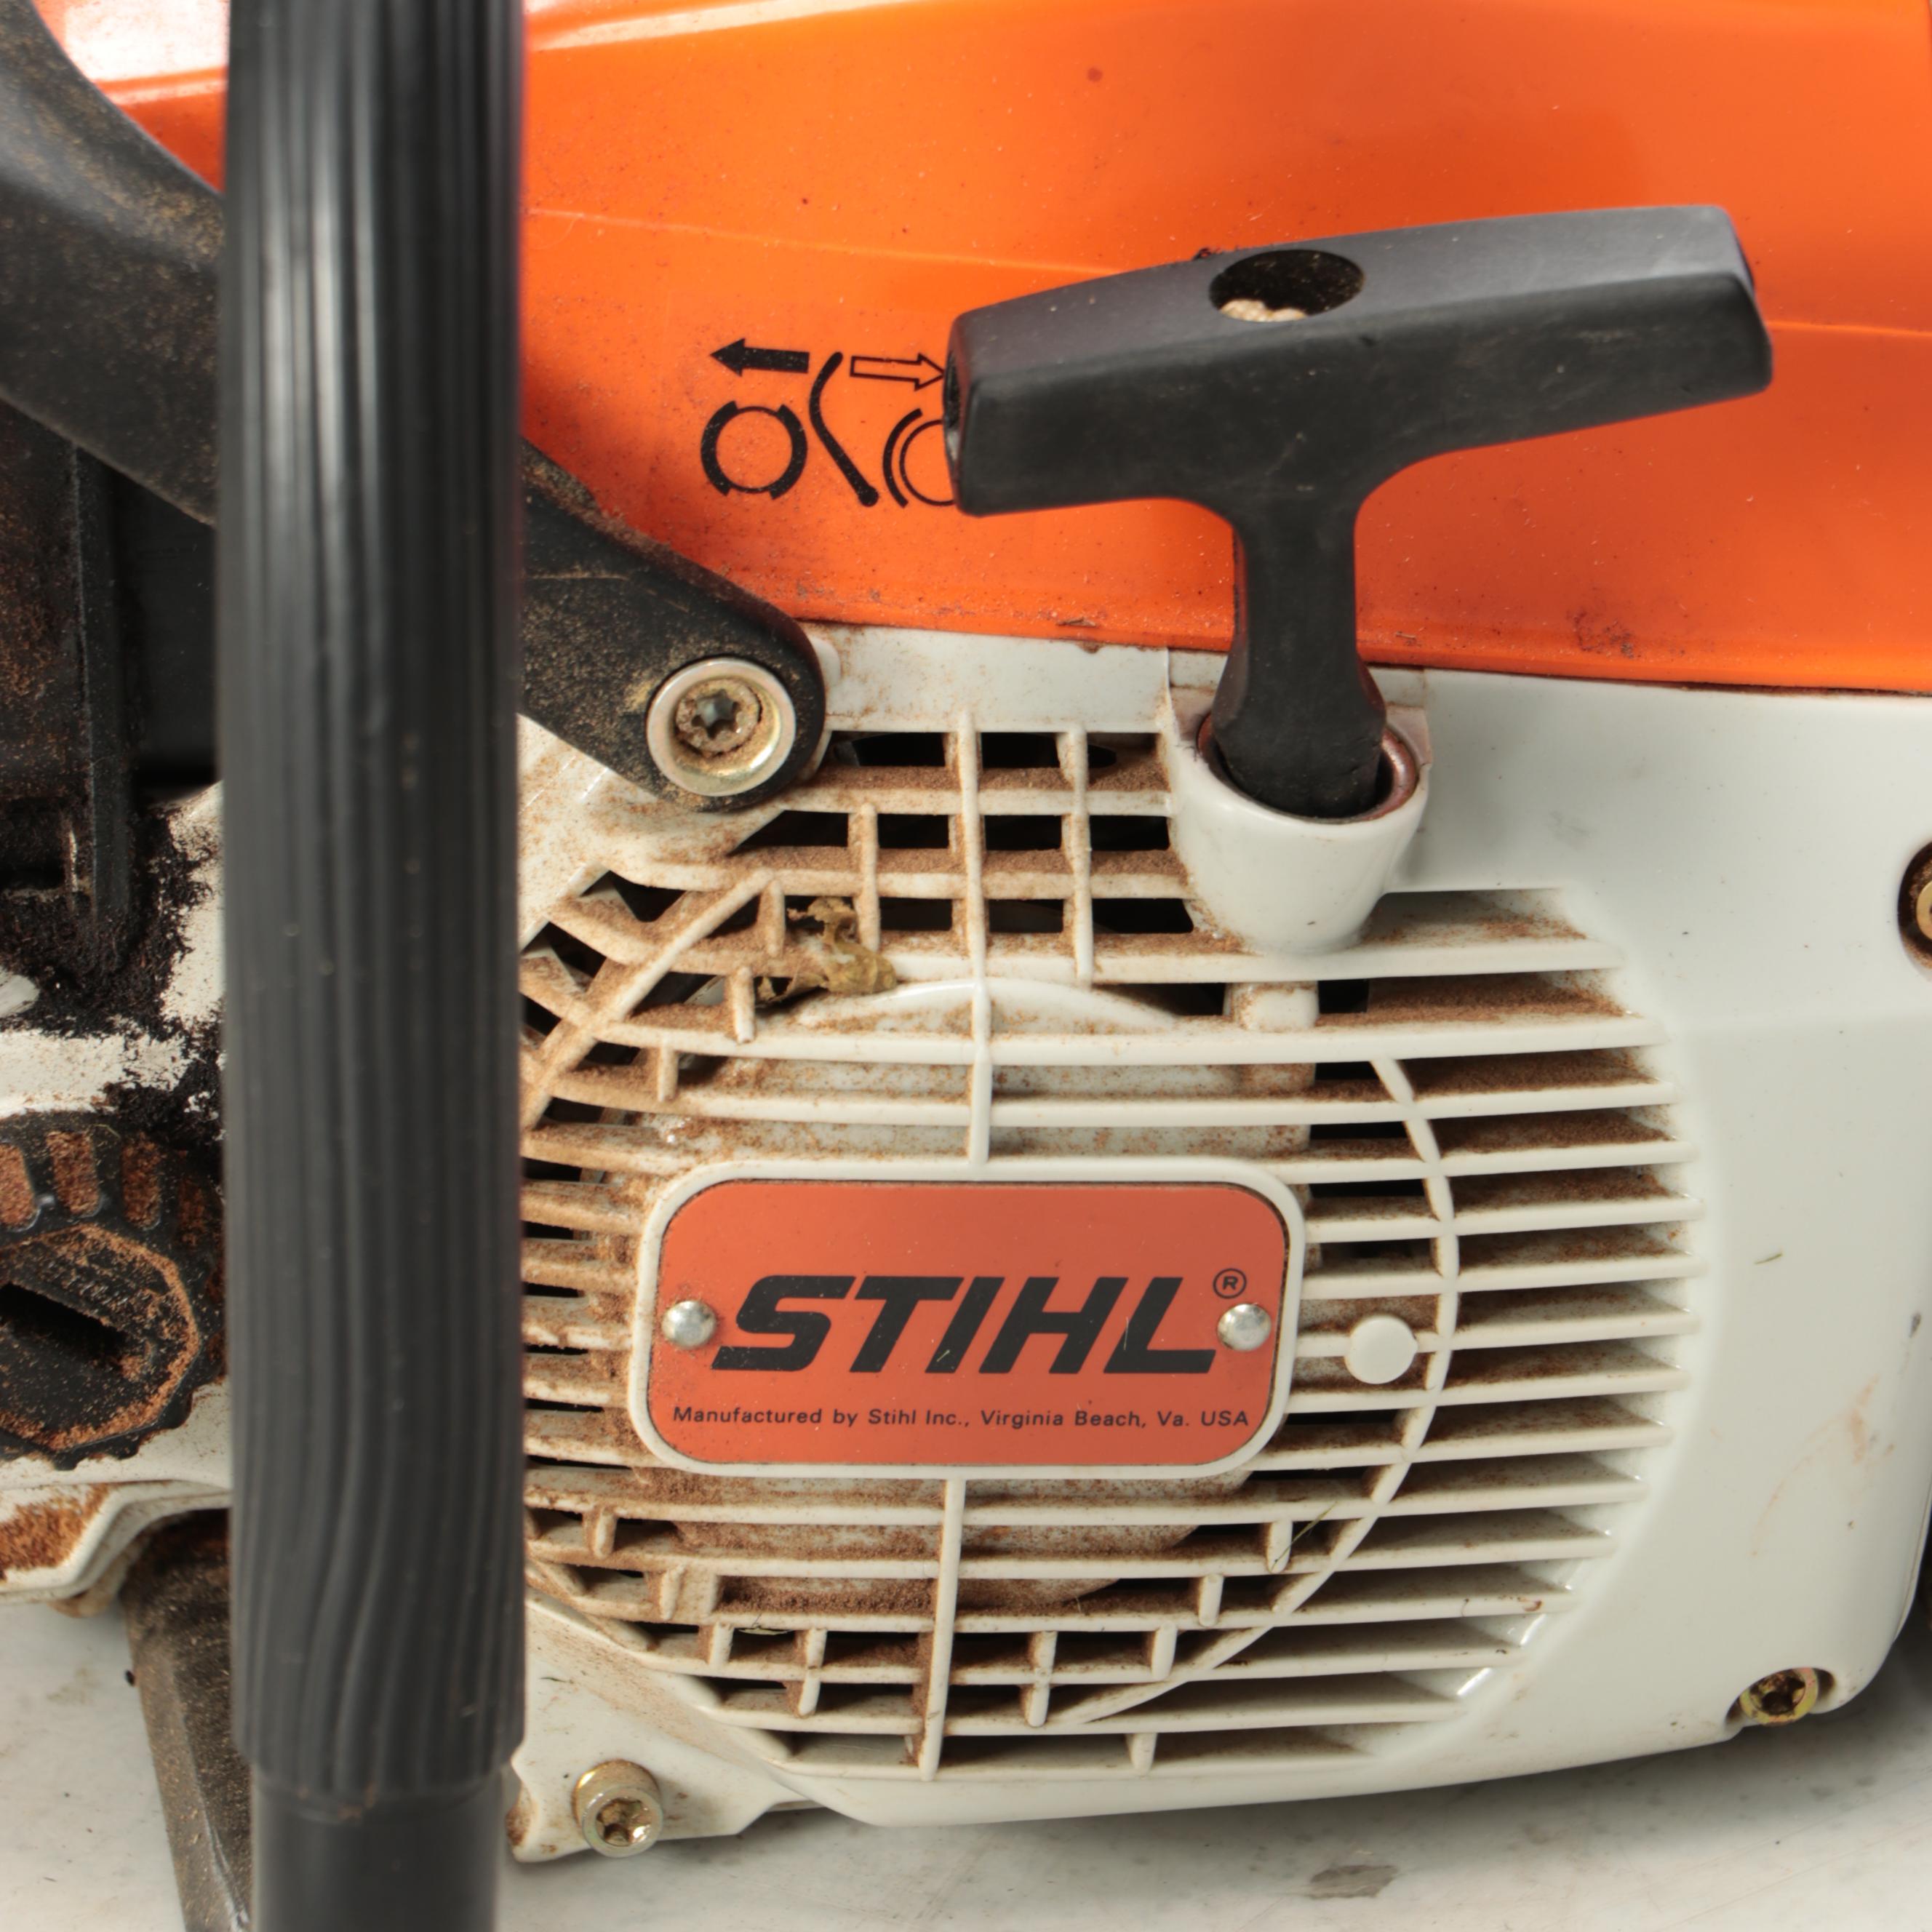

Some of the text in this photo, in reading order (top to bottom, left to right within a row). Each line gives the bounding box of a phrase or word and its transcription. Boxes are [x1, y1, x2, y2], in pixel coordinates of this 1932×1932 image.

[710, 1274, 1217, 1375] STIHL
[673, 1406, 1250, 1429] Manufactured by Stihl Inc., Virginia Beach, Va. USA
